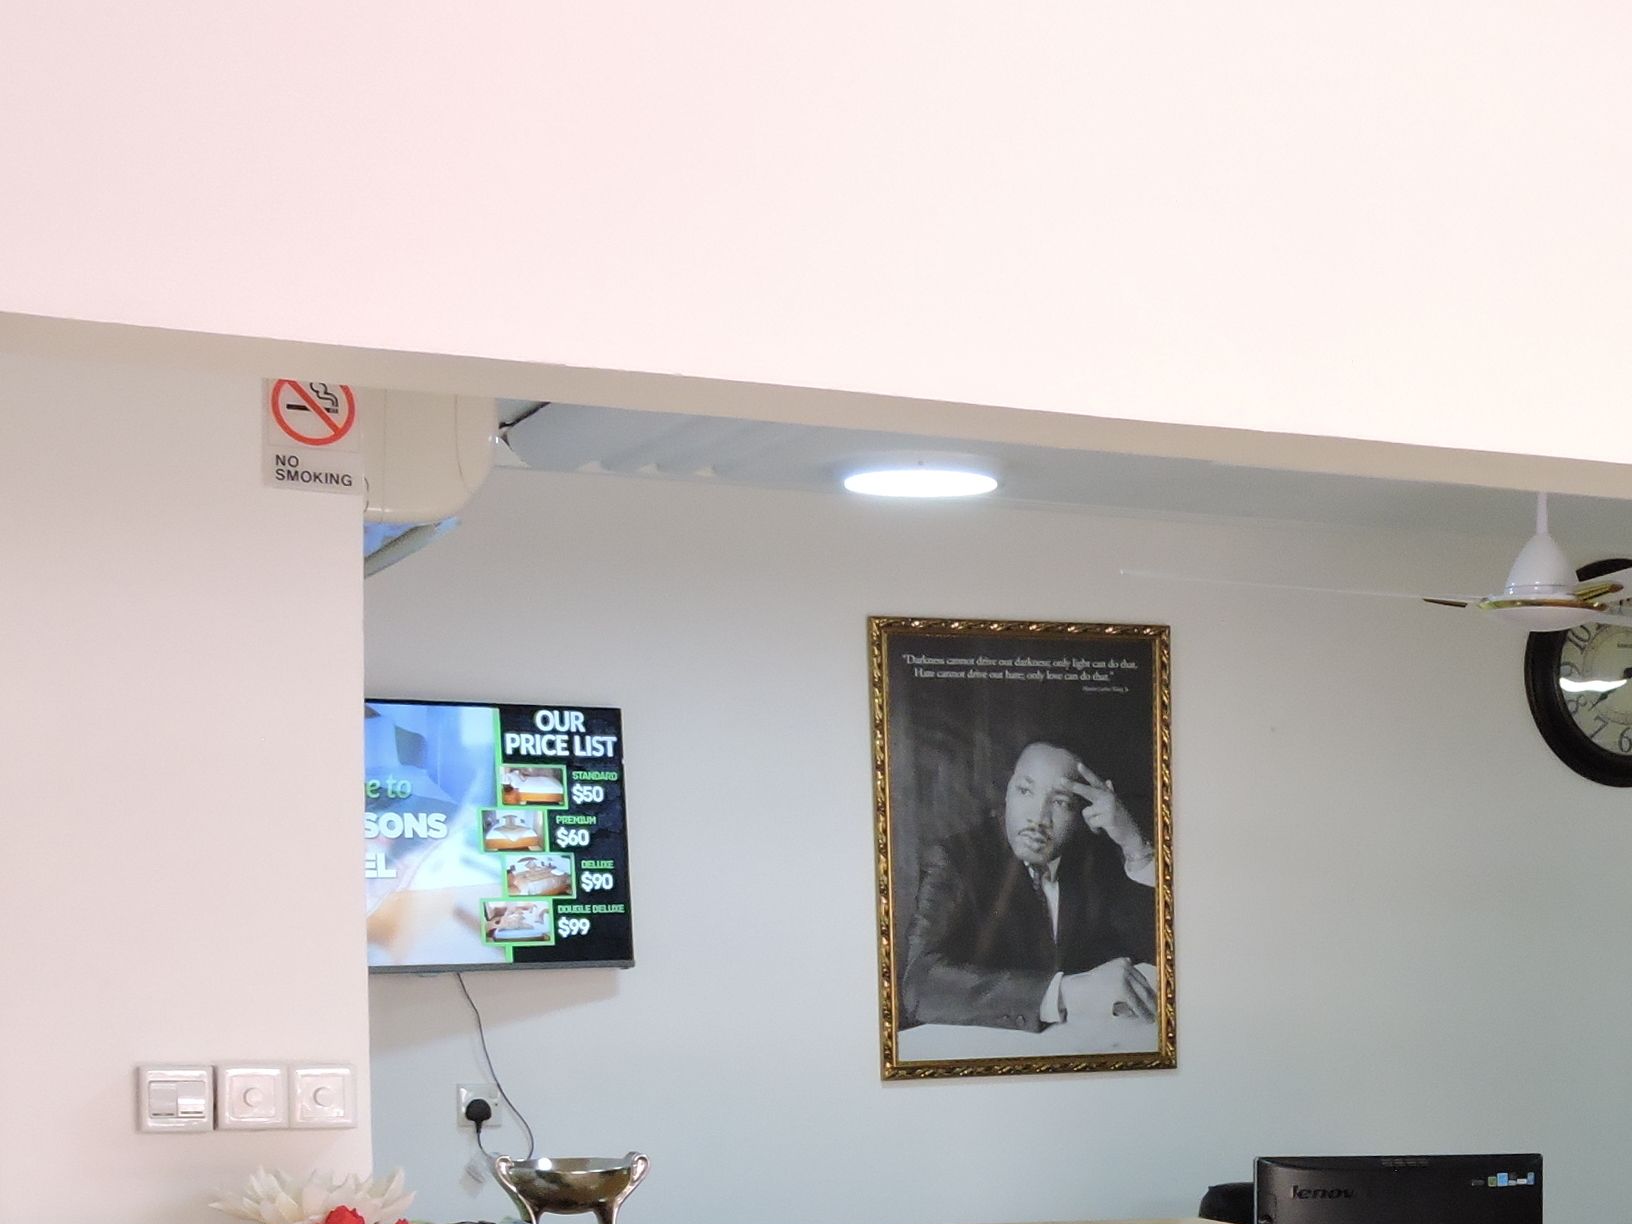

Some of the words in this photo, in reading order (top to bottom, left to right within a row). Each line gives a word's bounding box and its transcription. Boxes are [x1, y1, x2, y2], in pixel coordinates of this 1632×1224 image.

[275, 454, 299, 468] NO
[275, 468, 353, 487] SMOKING
[946, 657, 975, 665] cannot
[976, 655, 997, 666] drive
[998, 658, 1013, 666] out
[1052, 657, 1071, 670] only
[1072, 657, 1090, 670] light
[1092, 660, 1106, 668] can
[1107, 658, 1119, 668] do
[914, 667, 935, 678] Hate
[936, 670, 965, 678] cannot
[967, 669, 988, 679] drive
[988, 671, 1004, 679] out
[1026, 669, 1045, 682] only
[1046, 670, 1063, 680] love
[1064, 672, 1079, 680] can
[1080, 671, 1091, 680] do
[1567, 694, 1587, 715] 8
[535, 710, 585, 732] OUR
[1590, 715, 1609, 739] 7
[504, 733, 570, 756] PRICE
[573, 735, 618, 757] LIST
[1618, 727, 1632, 753] 6
[386, 774, 412, 799] to
[572, 771, 618, 781] STANDARD
[571, 783, 604, 804] $50
[555, 815, 597, 825] PREMIUM
[556, 826, 590, 848] $60
[581, 860, 615, 869] DELUXE
[581, 871, 614, 892] $90
[557, 904, 591, 914] DOUBLE
[592, 904, 625, 913] DELUXE
[558, 916, 591, 938] $99
[1291, 1184, 1357, 1201] lenov
